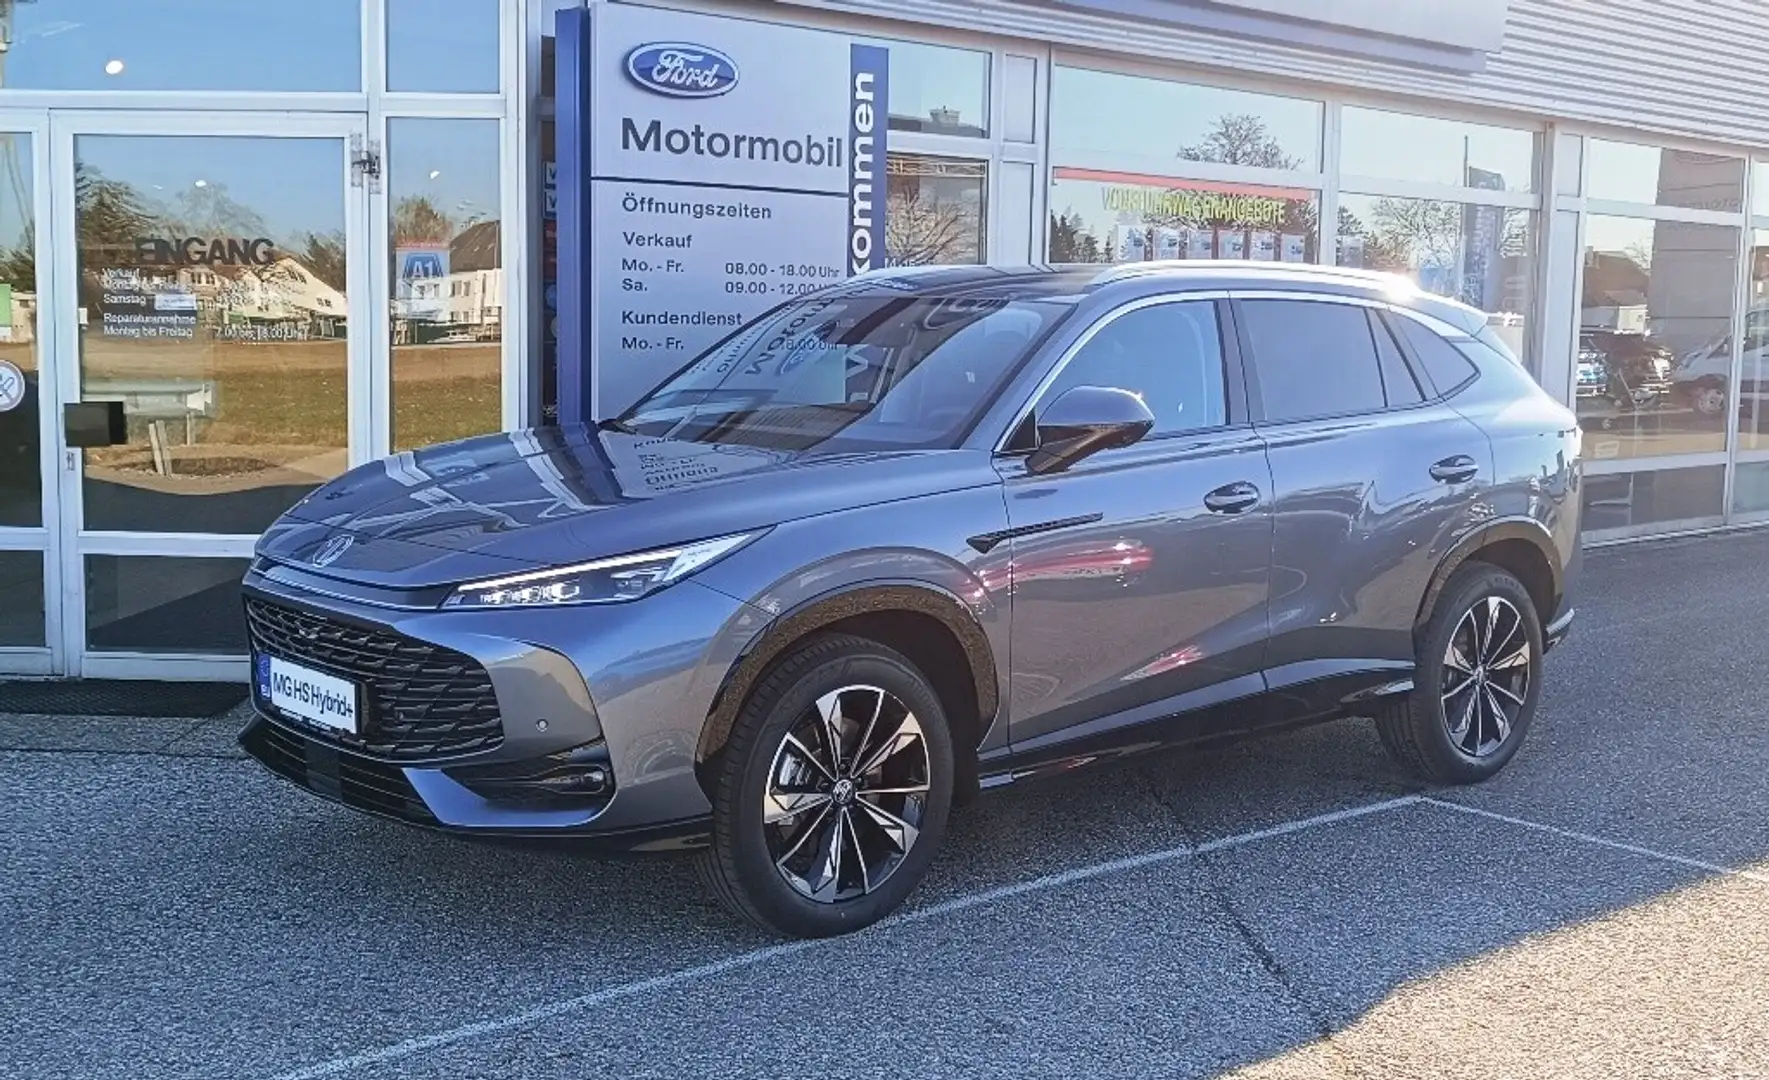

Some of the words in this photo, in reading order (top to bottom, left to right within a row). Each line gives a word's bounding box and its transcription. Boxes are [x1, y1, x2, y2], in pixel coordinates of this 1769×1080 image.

[652, 50, 720, 87] Ford
[621, 117, 843, 168] Motormobil
[621, 192, 772, 219] Öffnungszeiten
[622, 231, 692, 248] Verkauf
[136, 237, 274, 265] EINGANG
[411, 260, 433, 278] A1
[621, 258, 653, 273] Mo.
[666, 260, 685, 273] Fr.
[725, 262, 768, 276] 08.00
[779, 264, 816, 278] 18.00
[818, 266, 839, 278] Uhr
[621, 278, 648, 291] Sa.
[725, 281, 767, 295] 09.00
[103, 293, 147, 307] Samstag
[621, 311, 743, 326] Kundendienst
[103, 325, 141, 338] Montag
[159, 326, 193, 339] Freitag
[621, 337, 653, 350] Mo.
[666, 338, 685, 350] Fr.
[273, 672, 292, 698] MG
[294, 679, 310, 703] HS
[311, 684, 354, 718] Hybrid+
